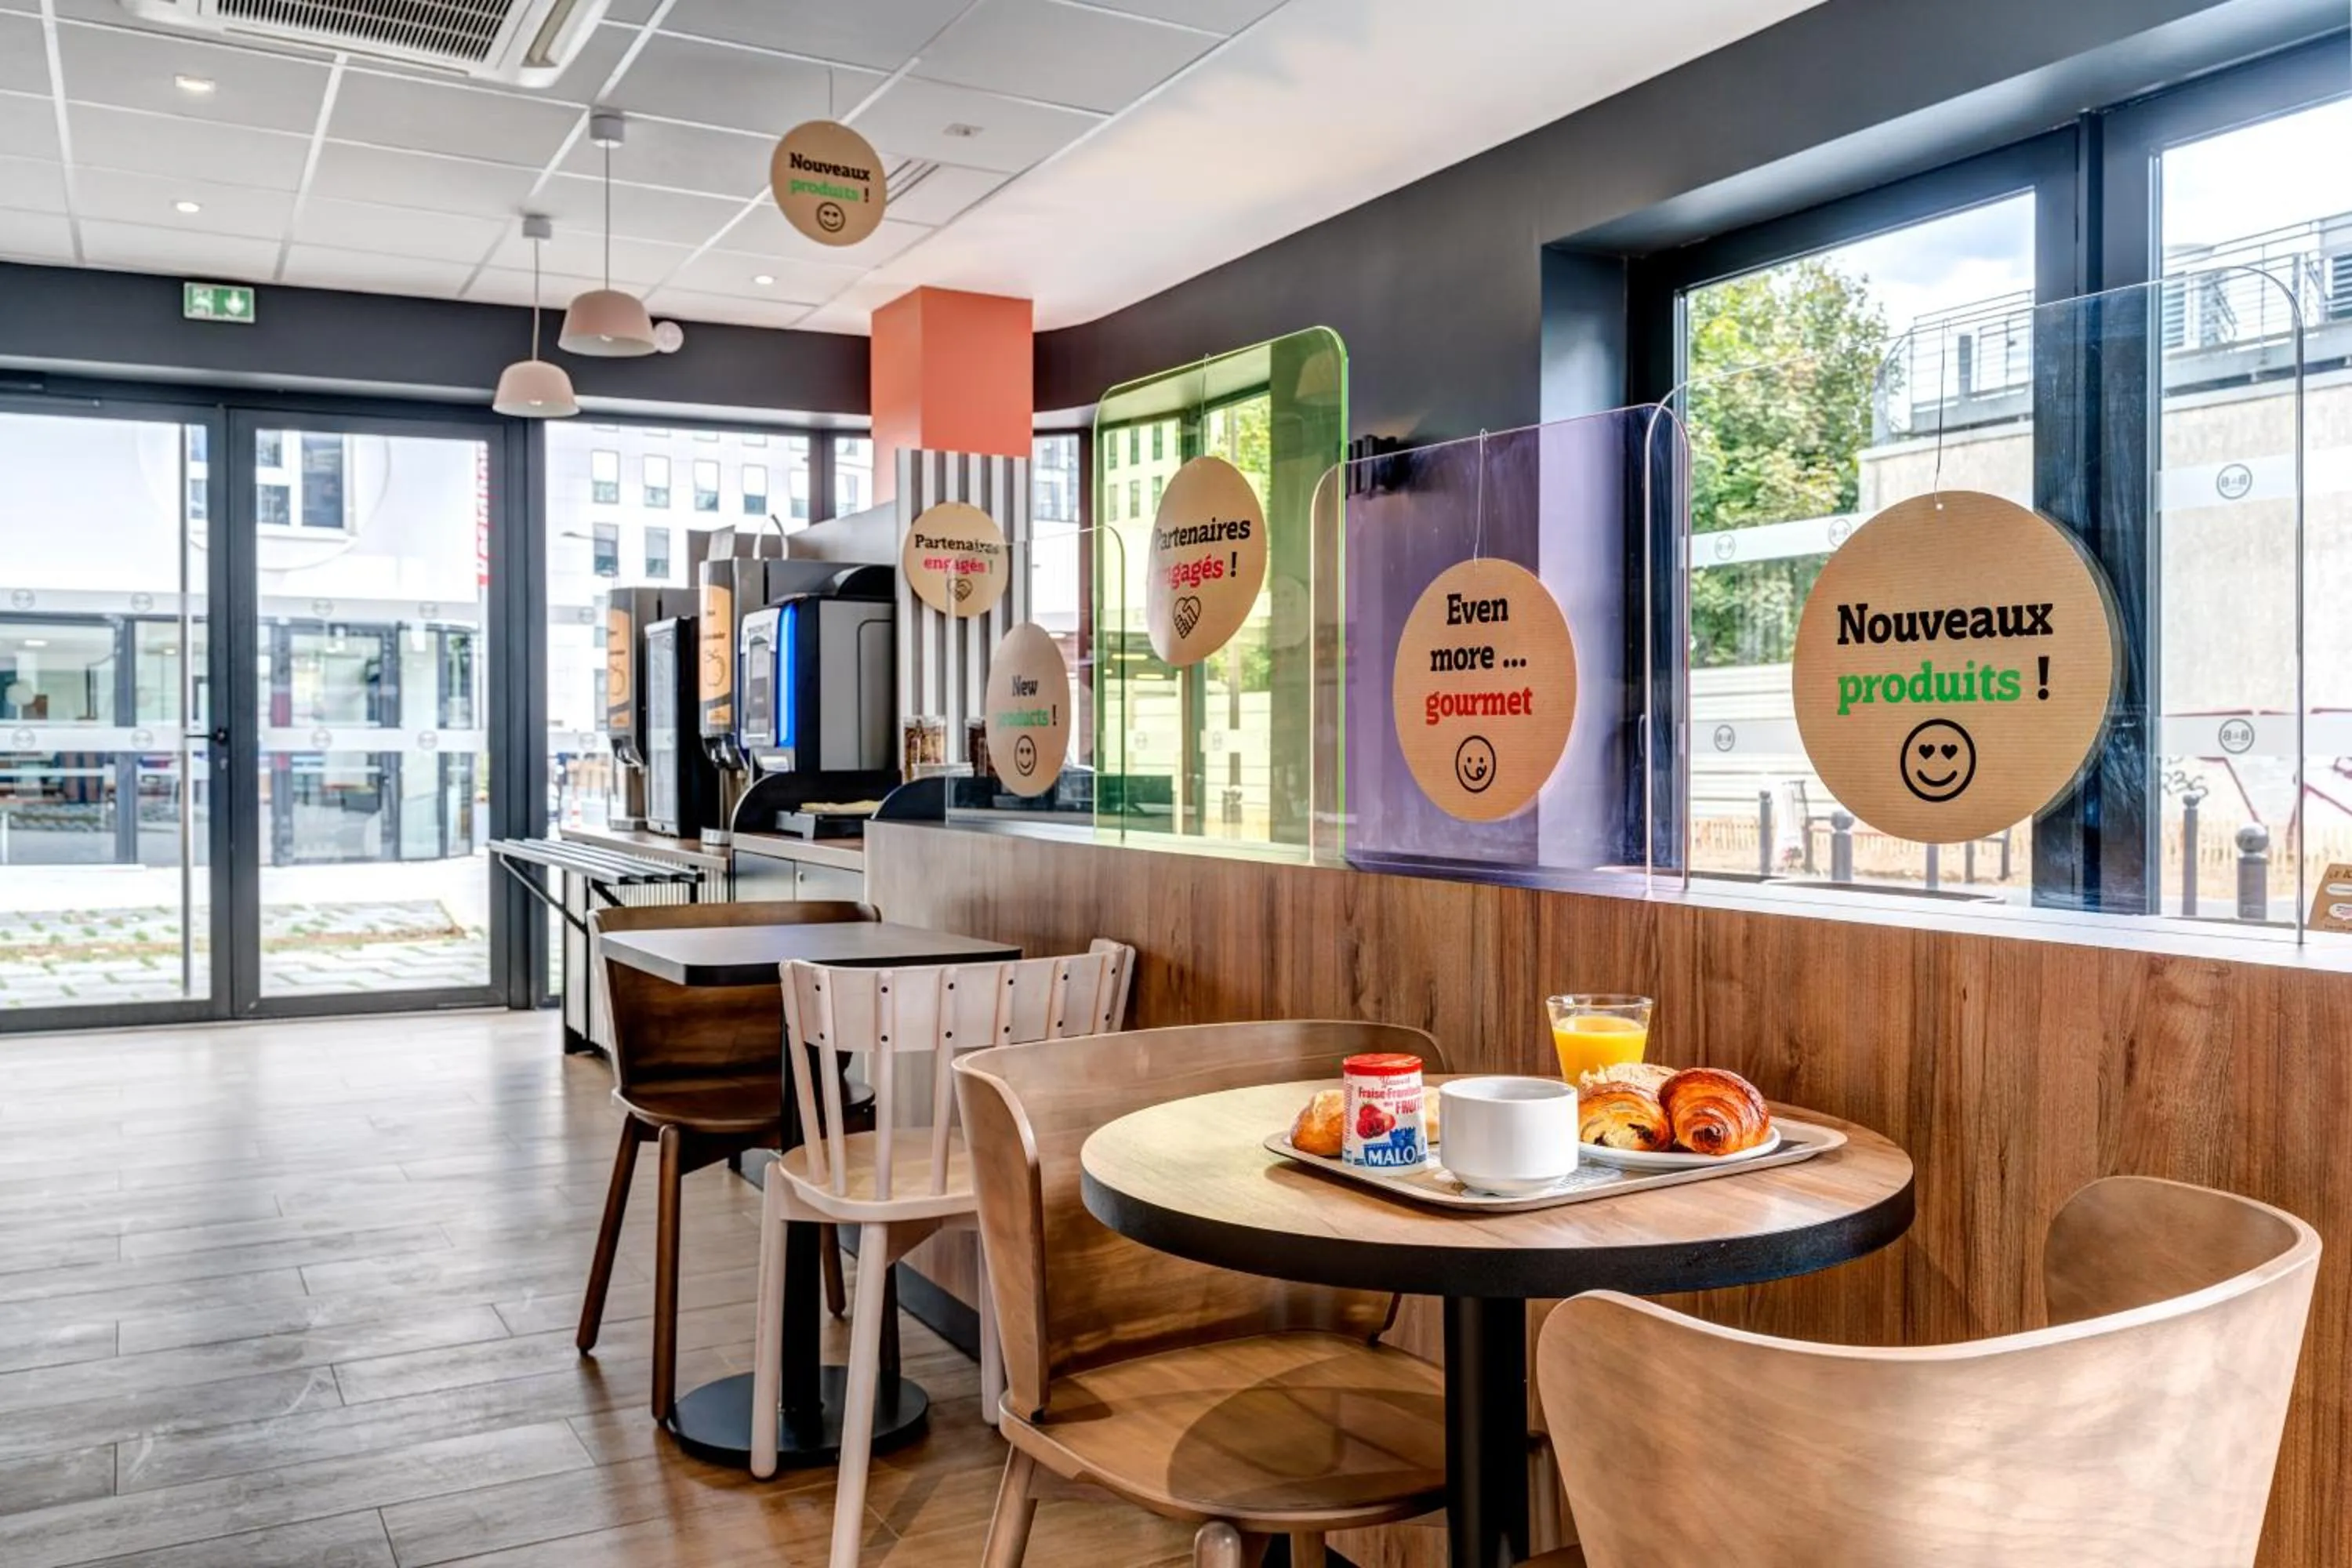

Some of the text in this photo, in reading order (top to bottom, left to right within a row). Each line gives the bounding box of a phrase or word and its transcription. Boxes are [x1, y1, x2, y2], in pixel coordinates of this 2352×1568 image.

[789, 152, 870, 181] Nouveaux
[790, 179, 869, 202] produits !
[915, 534, 999, 554] Partenaires
[1156, 517, 1250, 550] Partenaires
[1230, 552, 1237, 577] !
[1446, 593, 1508, 625] Even
[1837, 603, 2053, 645] Nouveaux
[1430, 646, 1494, 671] more
[1012, 675, 1038, 696] New
[1837, 656, 2049, 715] produits !
[996, 704, 1056, 731] products !
[1425, 688, 1532, 725] gourmet
[1368, 1145, 1416, 1166] MALO
